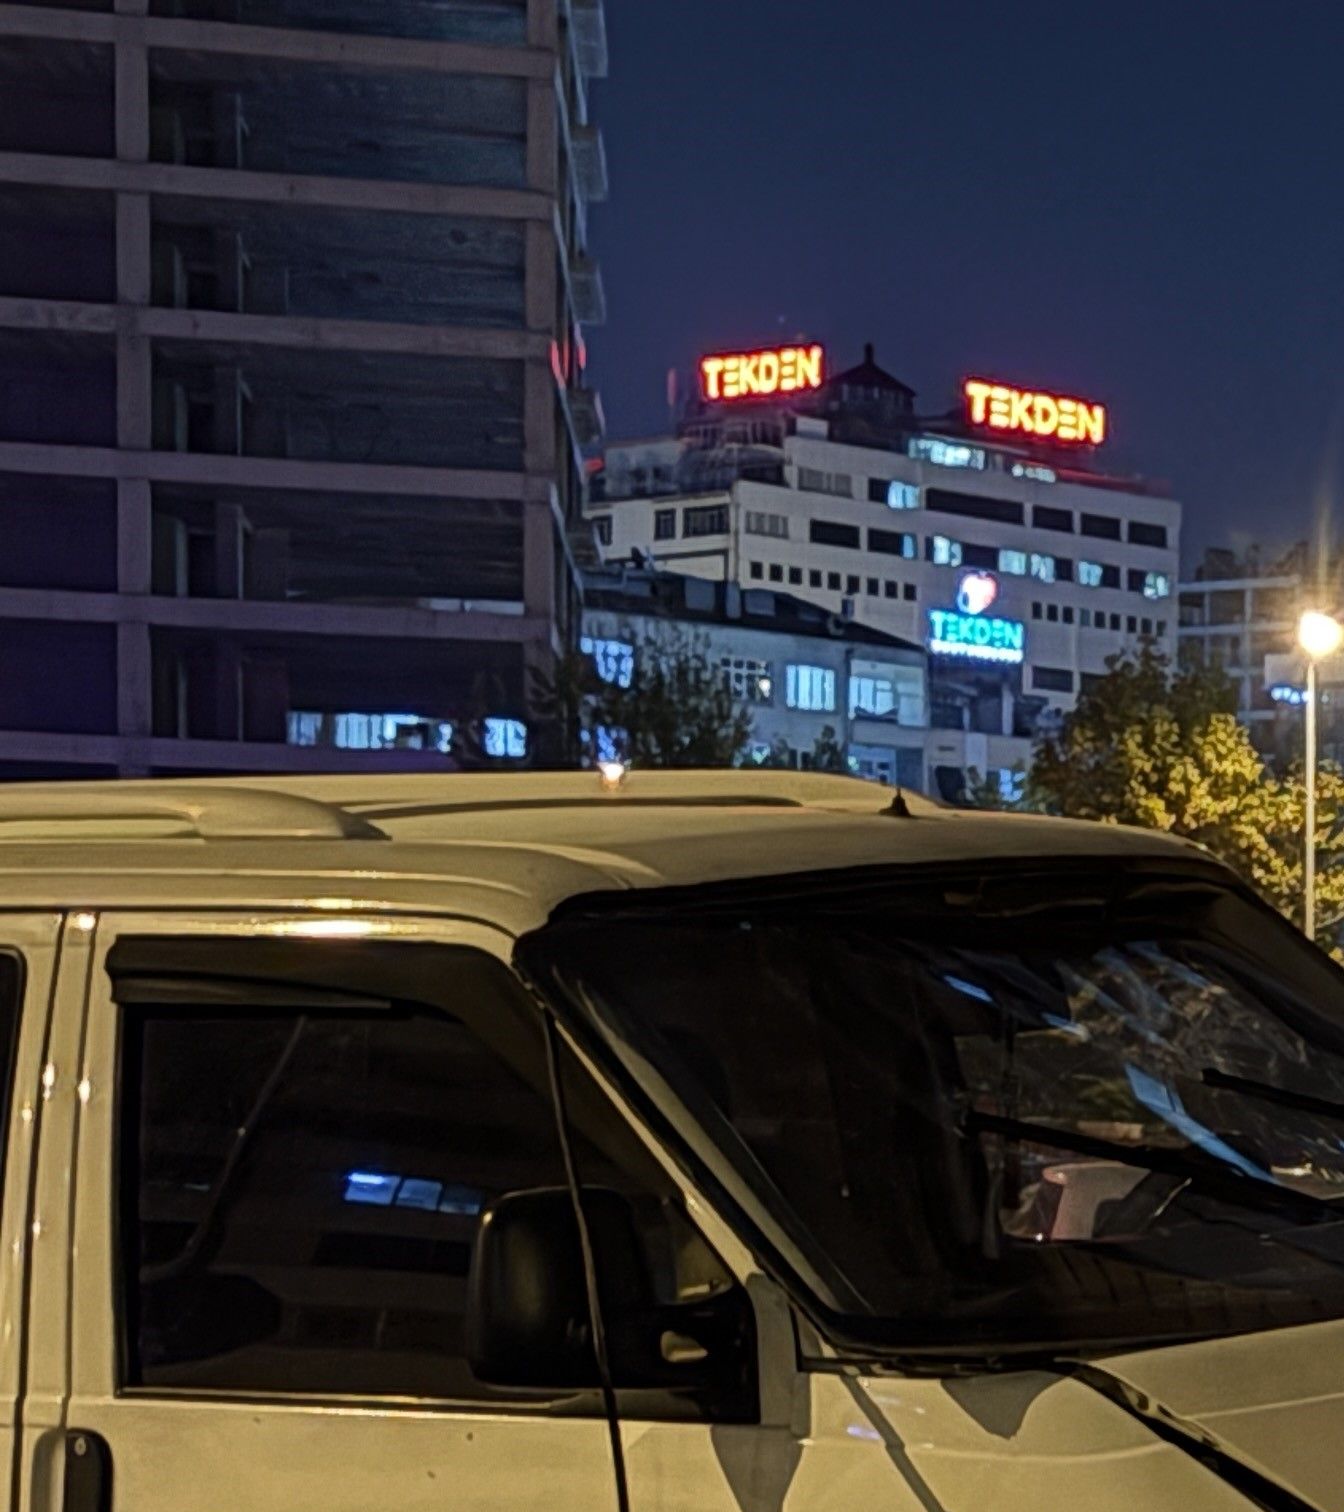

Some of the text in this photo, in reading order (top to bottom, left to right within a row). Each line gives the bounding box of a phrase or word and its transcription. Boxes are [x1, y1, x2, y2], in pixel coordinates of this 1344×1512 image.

[702, 345, 822, 399] TEKDEN
[965, 381, 1105, 444] TEKDEN
[930, 610, 1023, 649] TEKDEN
